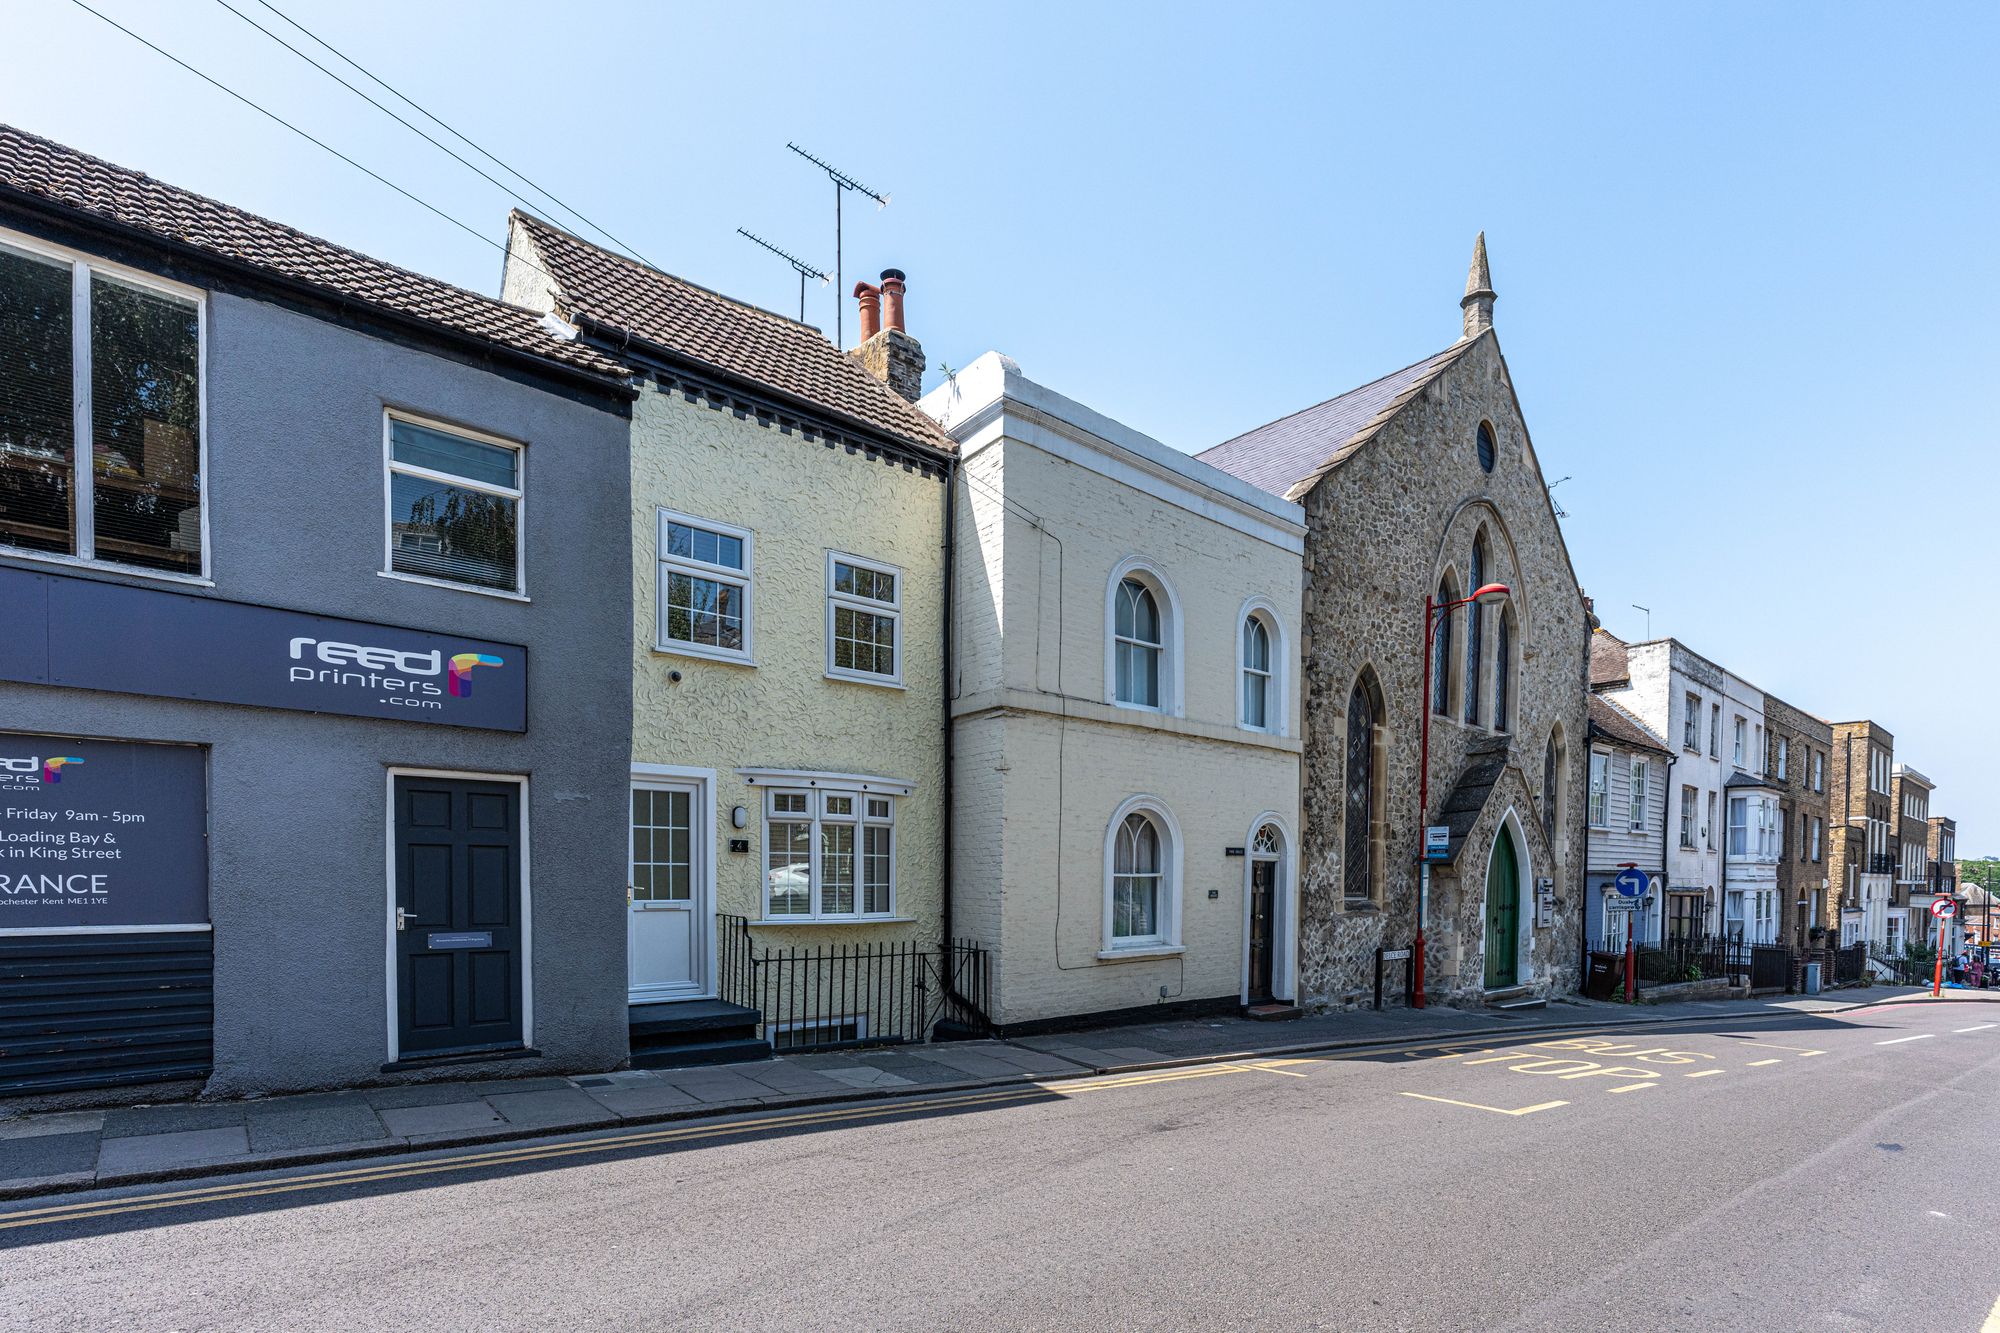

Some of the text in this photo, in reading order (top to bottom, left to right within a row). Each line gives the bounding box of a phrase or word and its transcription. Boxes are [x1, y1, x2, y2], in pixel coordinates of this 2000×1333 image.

[290, 637, 441, 676] reed
[290, 667, 442, 696] printers
[379, 697, 442, 710] .com
[6, 807, 58, 822] Friday
[65, 809, 99, 822] 9am
[112, 811, 145, 824] 5pm
[0, 831, 116, 846] Loading Bay &
[9, 846, 25, 858] in
[30, 846, 68, 861] King
[71, 847, 122, 859] Street
[42, 897, 64, 905] Kent
[67, 897, 88, 905] ME1
[91, 897, 108, 905] 1YE
[1404, 1045, 1662, 1080] STOP
